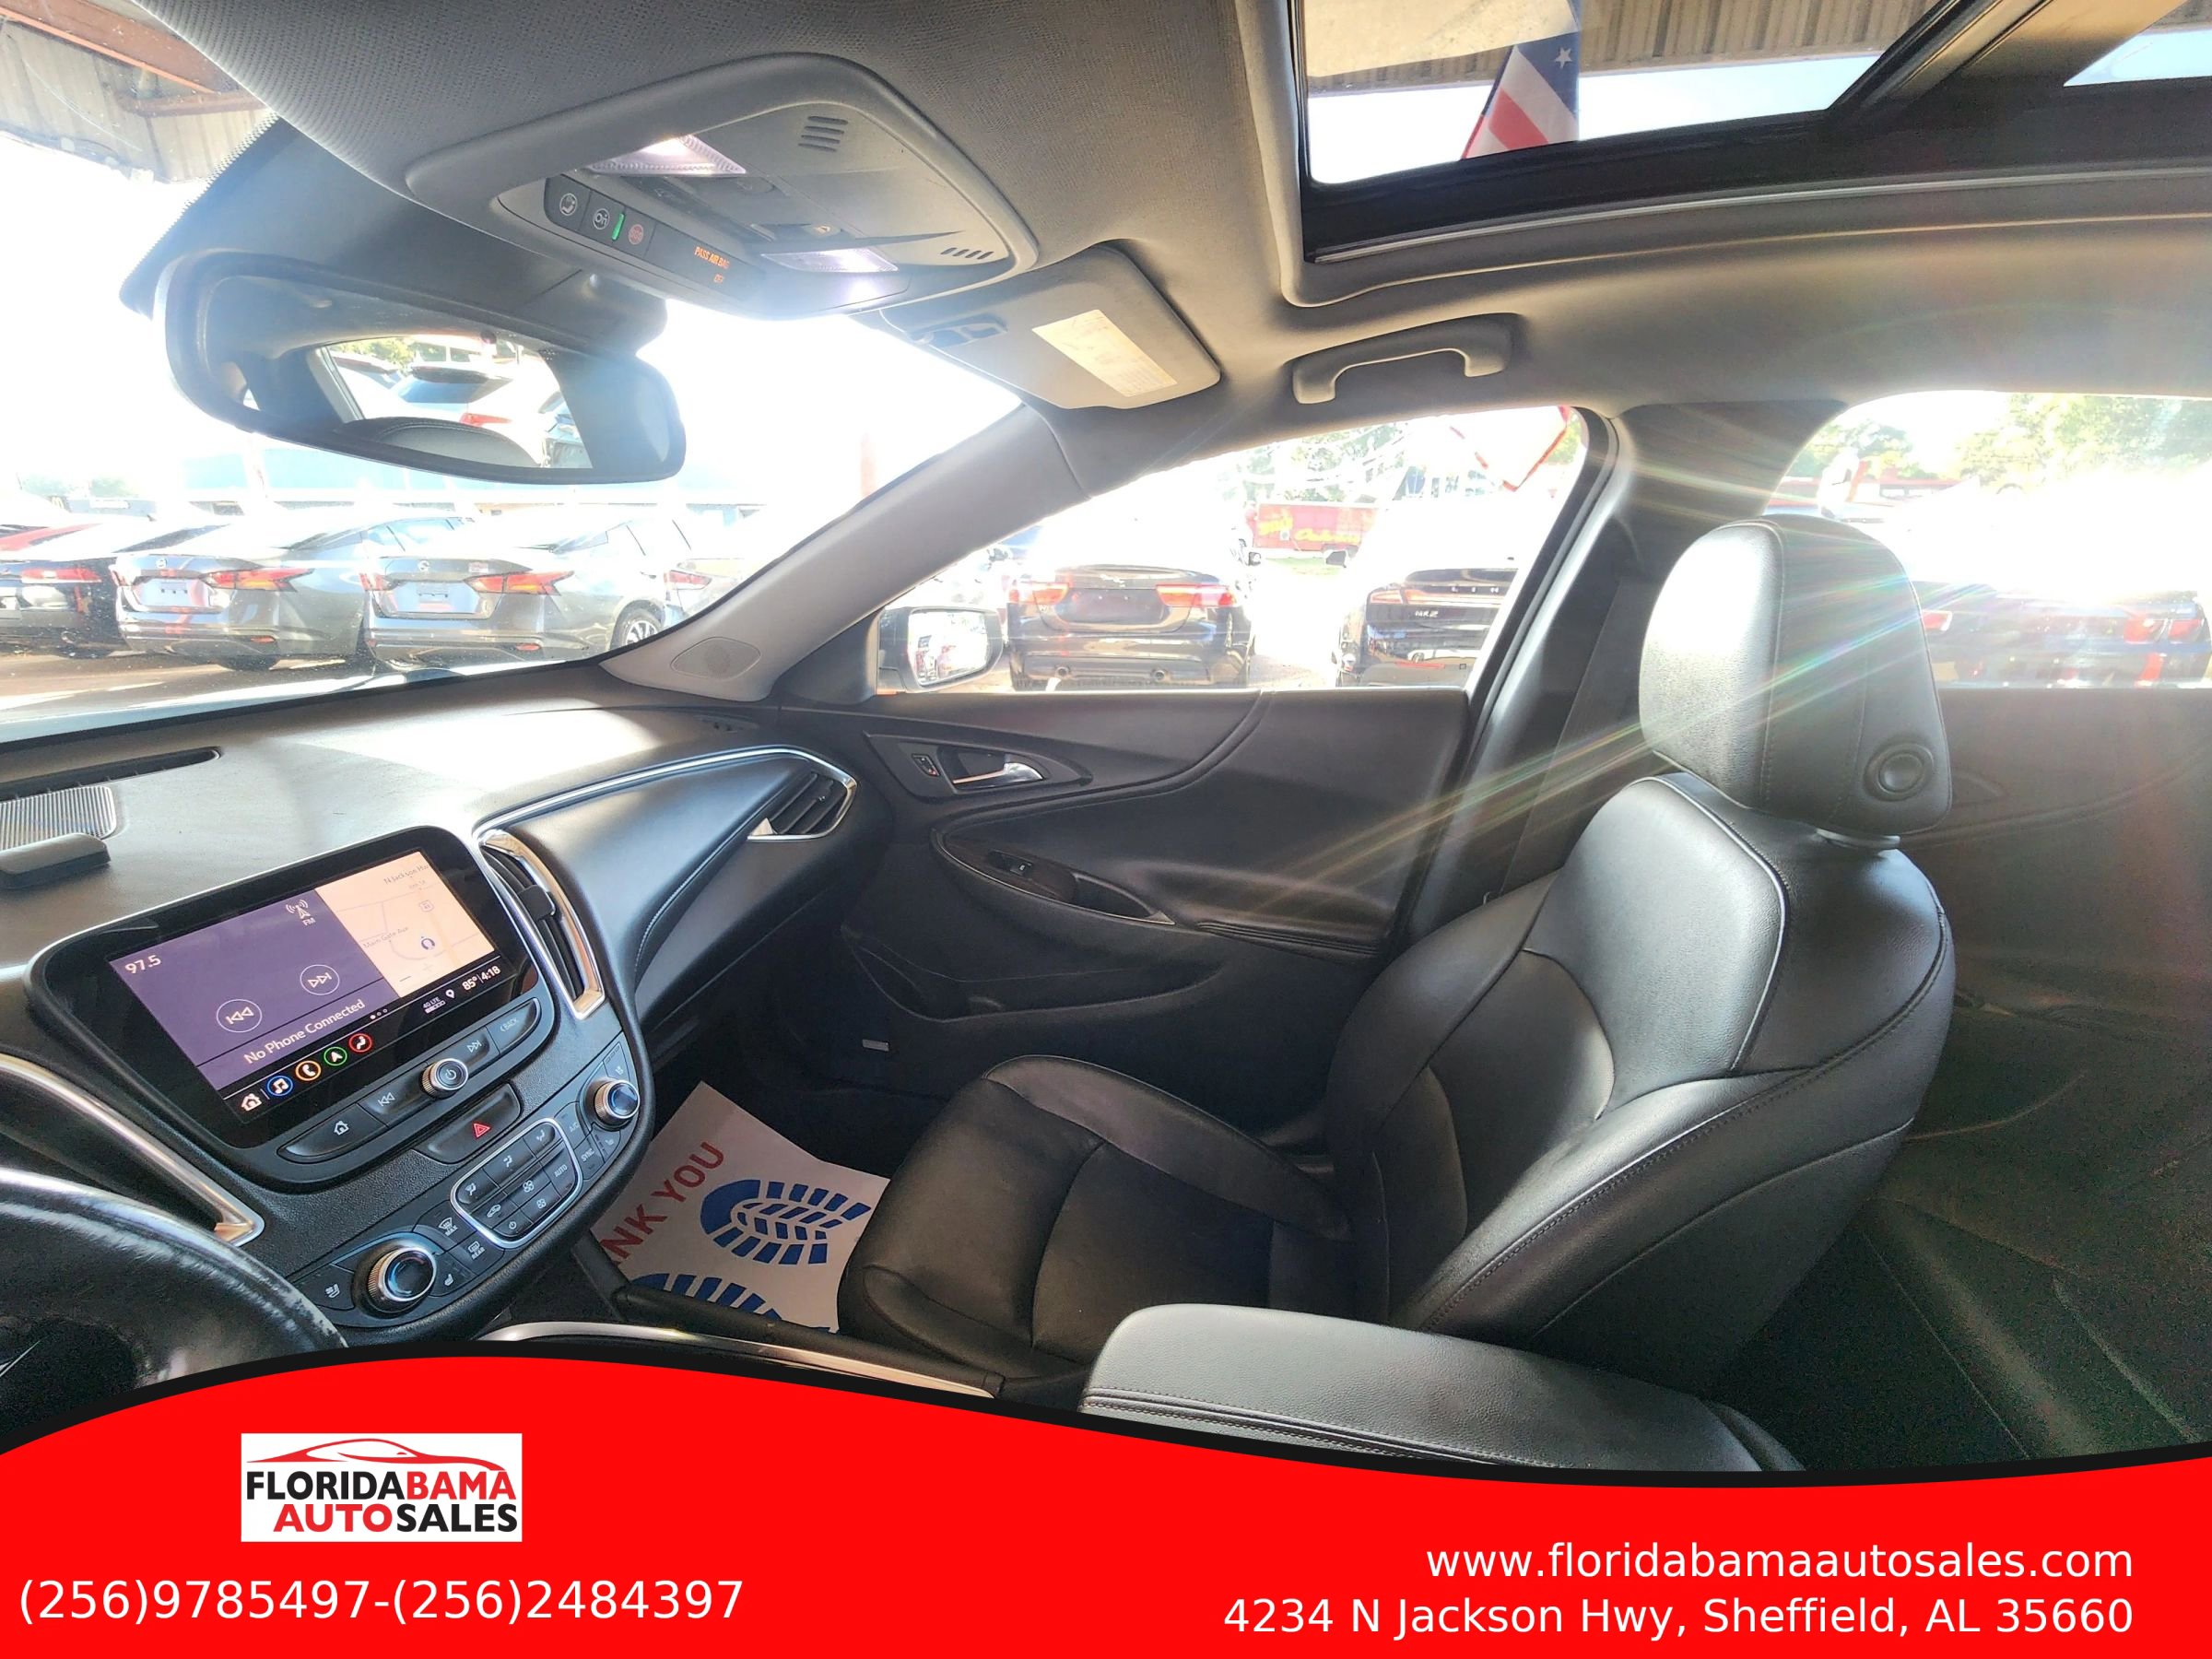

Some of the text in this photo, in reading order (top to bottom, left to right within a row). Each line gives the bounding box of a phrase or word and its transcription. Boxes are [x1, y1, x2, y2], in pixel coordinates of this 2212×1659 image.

[694, 246, 710, 262] PASS
[302, 917, 316, 926] FM
[125, 954, 162, 974] 97.5
[481, 965, 501, 981] 4:18
[430, 996, 441, 1006] LTE
[504, 1018, 520, 1031] BACK
[243, 999, 366, 1065] No Phone Connected
[581, 1148, 595, 1162] SYNC
[554, 1164, 568, 1178] AUTO
[600, 1141, 724, 1265] NK YOU
[445, 1224, 459, 1237] MAX
[471, 1246, 486, 1260] REAR
